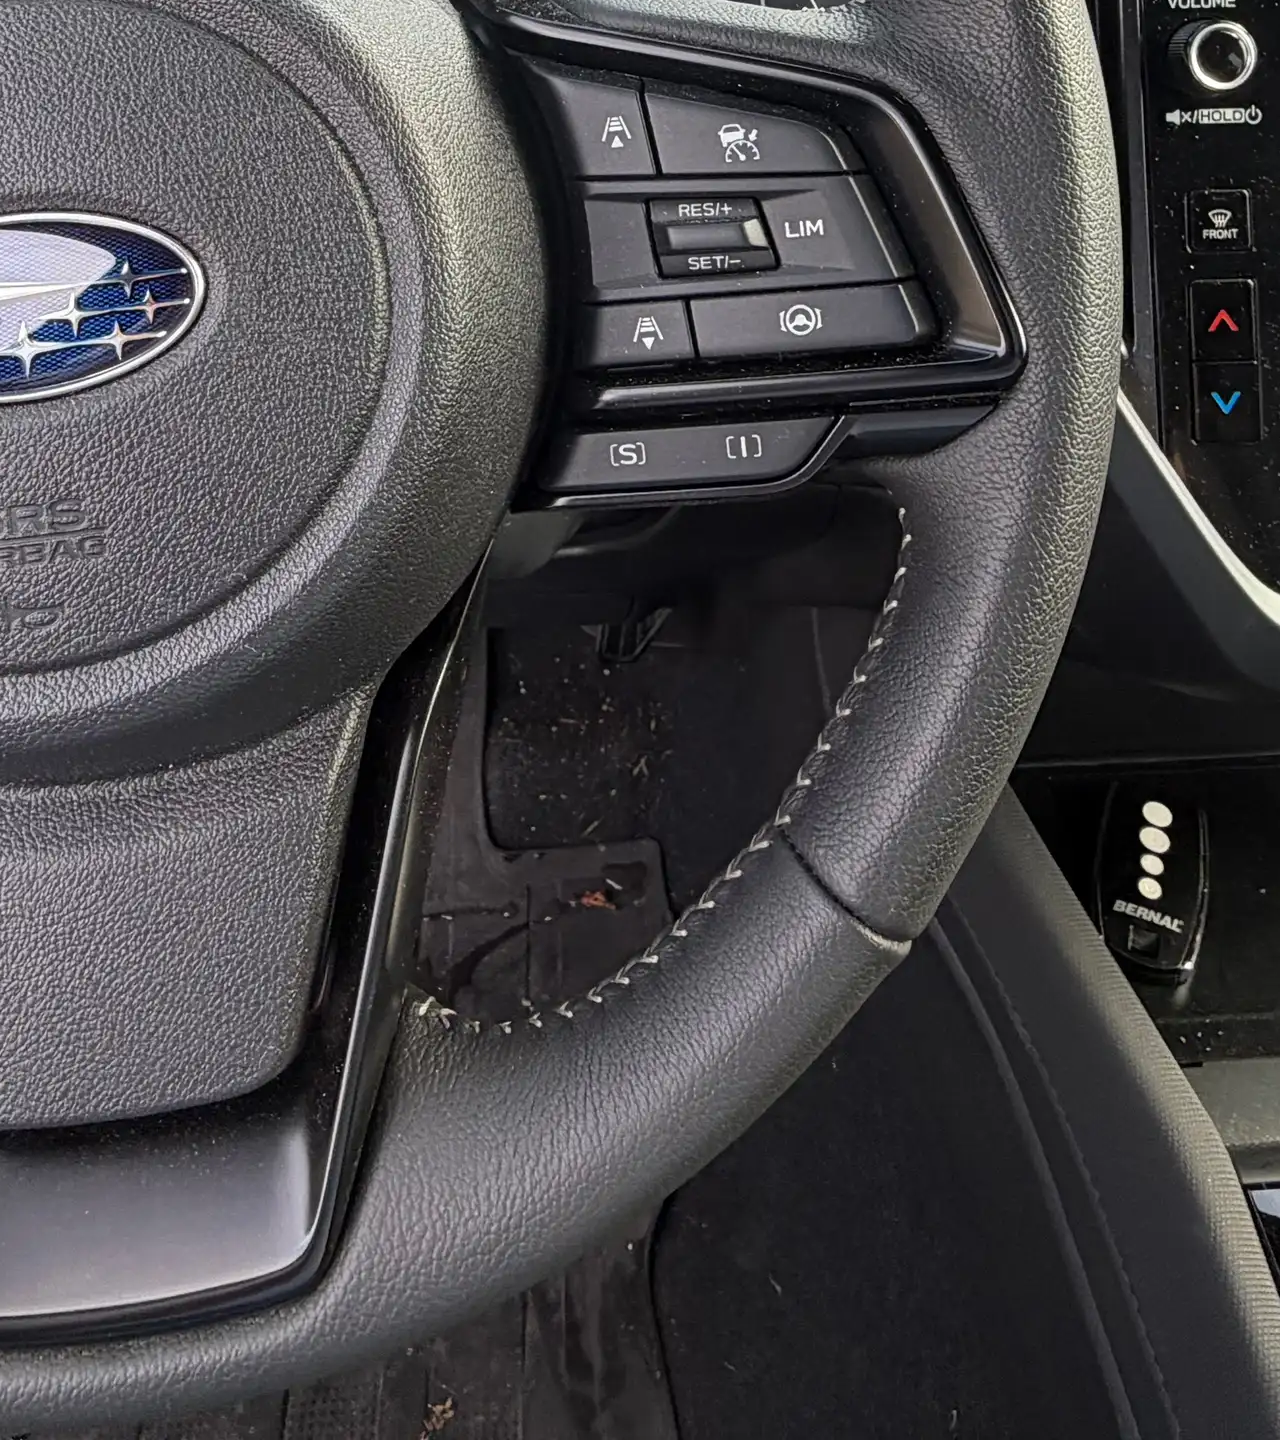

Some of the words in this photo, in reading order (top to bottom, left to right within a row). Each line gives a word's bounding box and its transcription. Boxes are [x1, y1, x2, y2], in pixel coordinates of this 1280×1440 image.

[1200, 109, 1244, 124] HOLD
[678, 202, 733, 217] RES/+
[785, 219, 824, 238] LIM
[1202, 229, 1239, 240] FRONT
[1112, 899, 1182, 933] BERNAL
